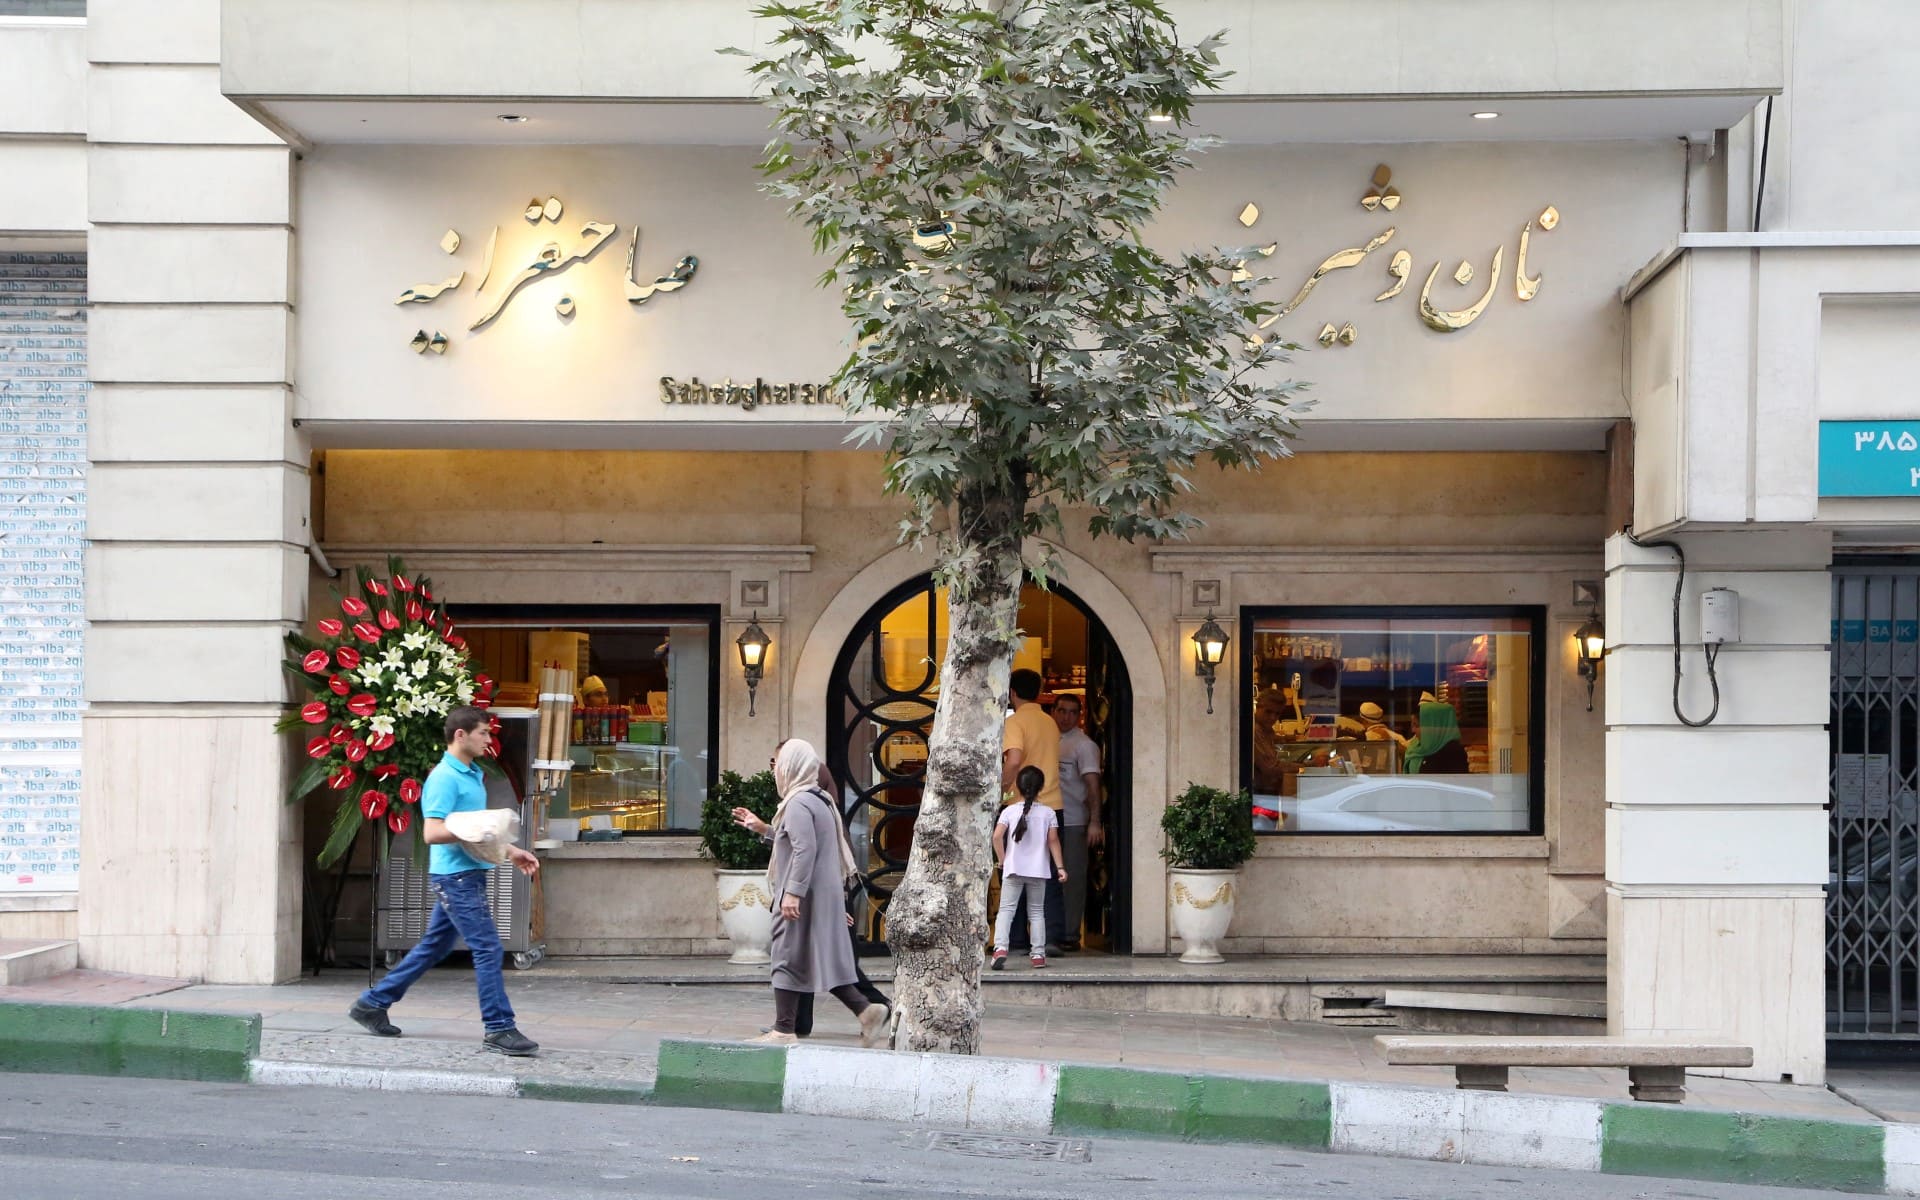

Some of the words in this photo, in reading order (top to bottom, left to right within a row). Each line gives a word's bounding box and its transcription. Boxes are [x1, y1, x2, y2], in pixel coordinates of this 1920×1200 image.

[10, 252, 34, 264] alba
[50, 252, 75, 264] alba
[24, 267, 49, 278] alba
[1419, 205, 1560, 333] نان
[1375, 248, 1413, 303] و
[1, 280, 25, 291] alba
[42, 280, 67, 291] alba
[33, 296, 57, 305] alba
[24, 310, 48, 320] alba
[6, 324, 30, 334] alba
[48, 324, 72, 335] alba
[16, 338, 41, 348] alba
[57, 338, 82, 348] alba
[25, 352, 50, 362] alba
[16, 367, 40, 376] alba
[57, 367, 82, 376] alba
[38, 392, 63, 402] alba
[36, 409, 61, 419] alba
[36, 422, 60, 432] alba
[15, 436, 39, 447] alba
[56, 436, 80, 446] alba
[10, 450, 35, 460] alba
[51, 450, 76, 460] alba
[48, 464, 73, 475] alba
[3, 479, 26, 488] alba
[43, 478, 68, 488] alba
[30, 492, 55, 502] alba
[54, 506, 78, 515] alba
[32, 520, 56, 530] alba
[16, 535, 40, 544] alba
[57, 535, 81, 544] alba
[33, 548, 57, 557] alba
[23, 561, 47, 571] alba
[14, 575, 38, 585] alba
[55, 575, 79, 585] alba
[23, 589, 48, 598] alba
[43, 616, 68, 626] alba
[25, 657, 49, 667] alba
[11, 698, 36, 708] alba
[53, 698, 77, 708] alba
[11, 712, 35, 721] alba
[51, 712, 76, 721] alba
[12, 739, 36, 749] alba
[52, 739, 77, 749] alba
[49, 794, 73, 804] alba
[2, 808, 27, 818] alba
[44, 808, 69, 817] alba
[48, 822, 72, 832] alba
[22, 850, 46, 860] alba
[32, 864, 56, 874] alba
